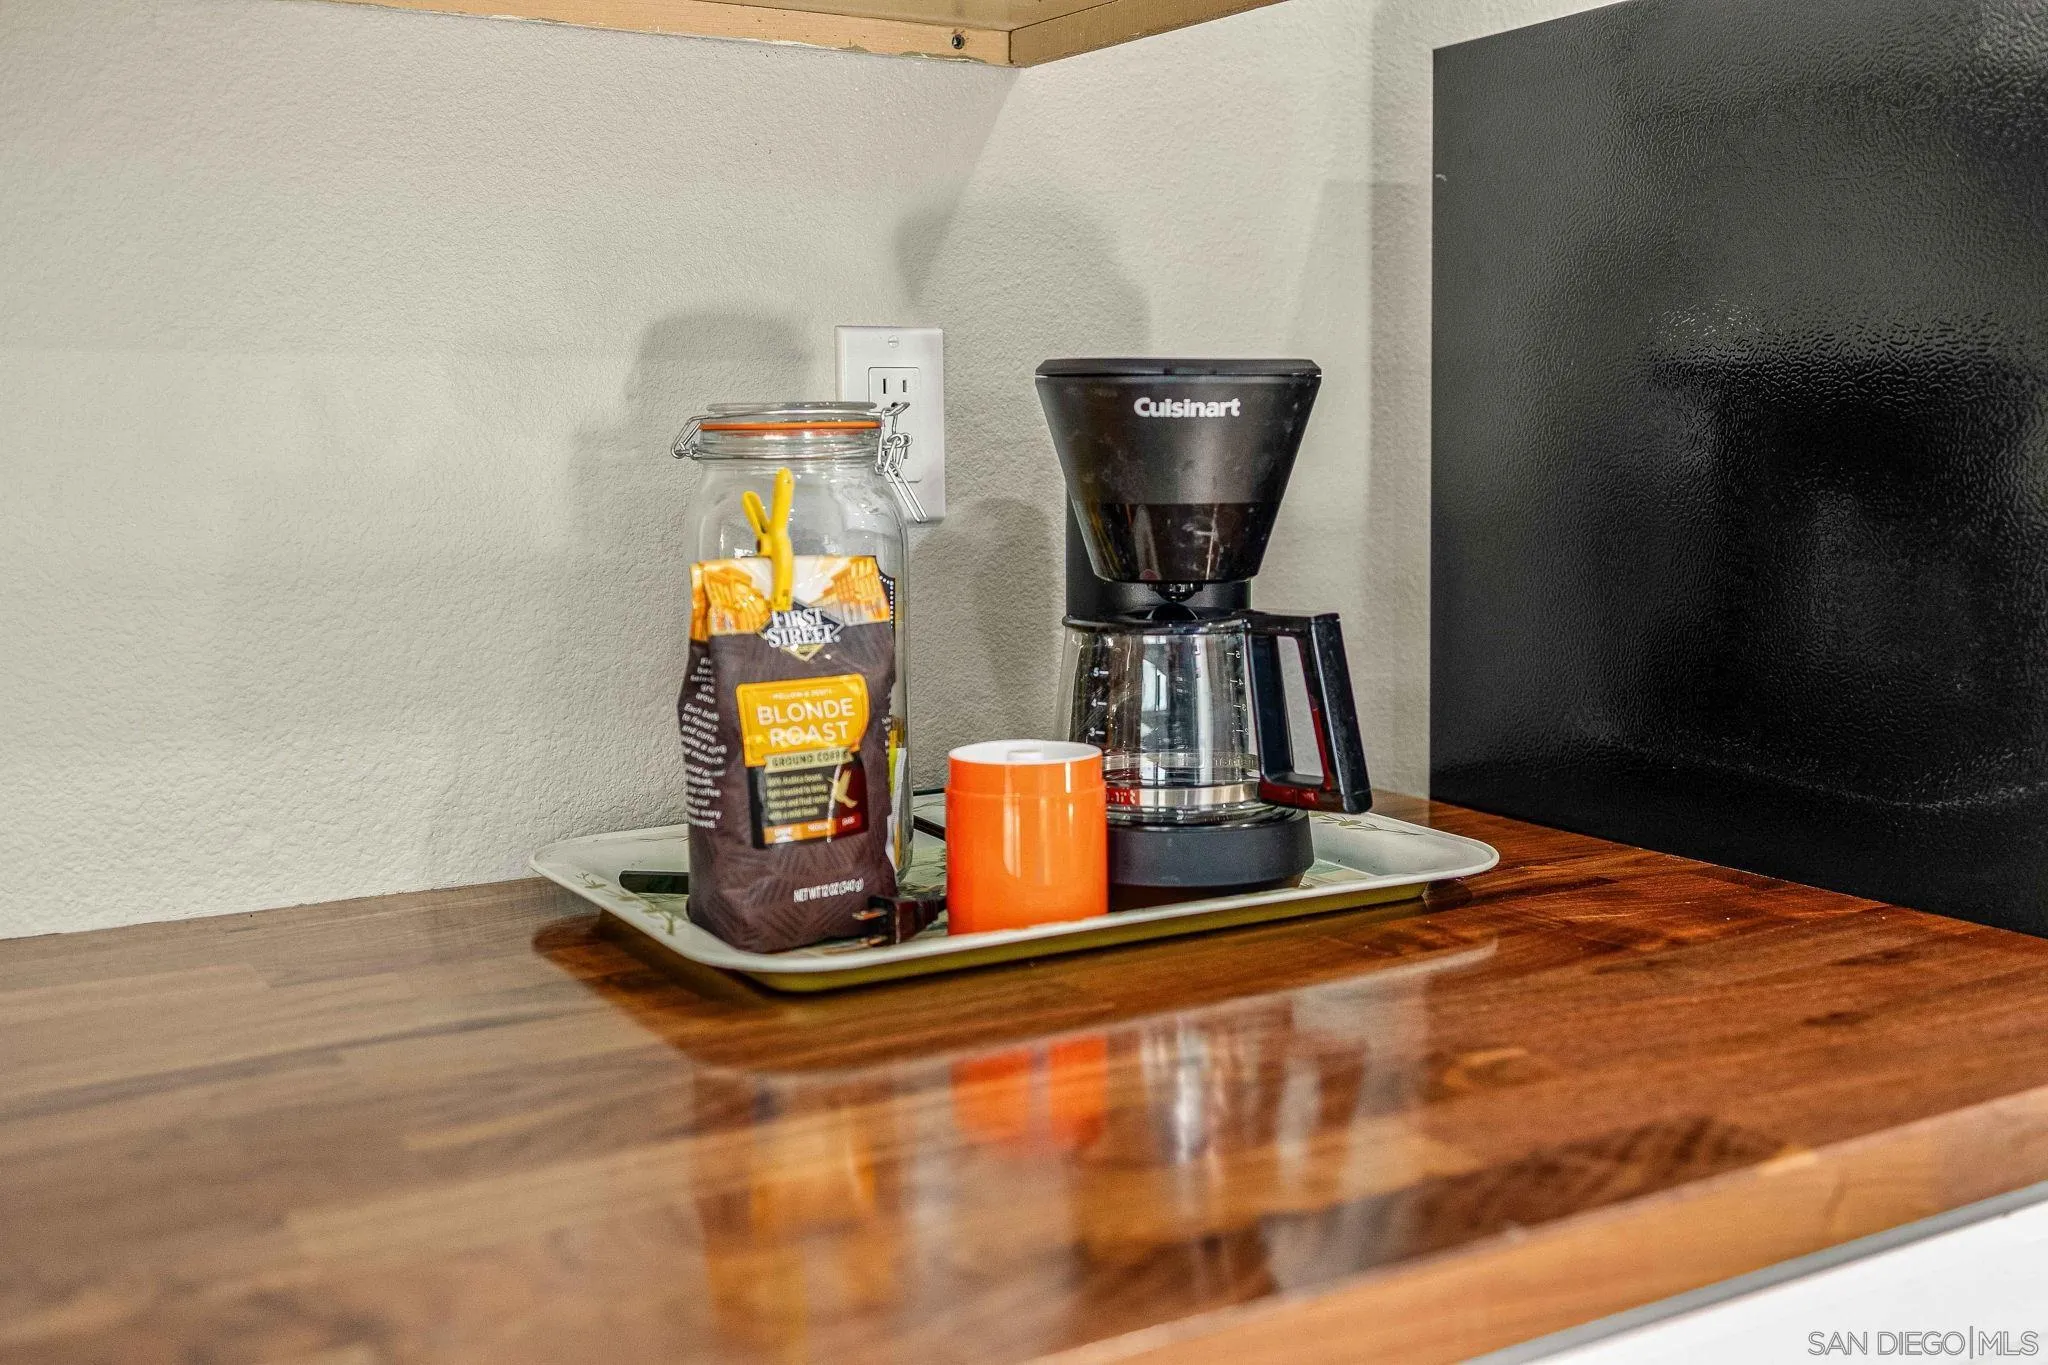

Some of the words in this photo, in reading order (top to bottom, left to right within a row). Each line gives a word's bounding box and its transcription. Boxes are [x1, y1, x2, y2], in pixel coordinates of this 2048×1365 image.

[1133, 397, 1241, 418] Cuisinart
[771, 607, 823, 628] FIRST
[757, 698, 856, 726] BLONDE
[769, 721, 849, 748] ROAST
[771, 754, 813, 768] GROUND
